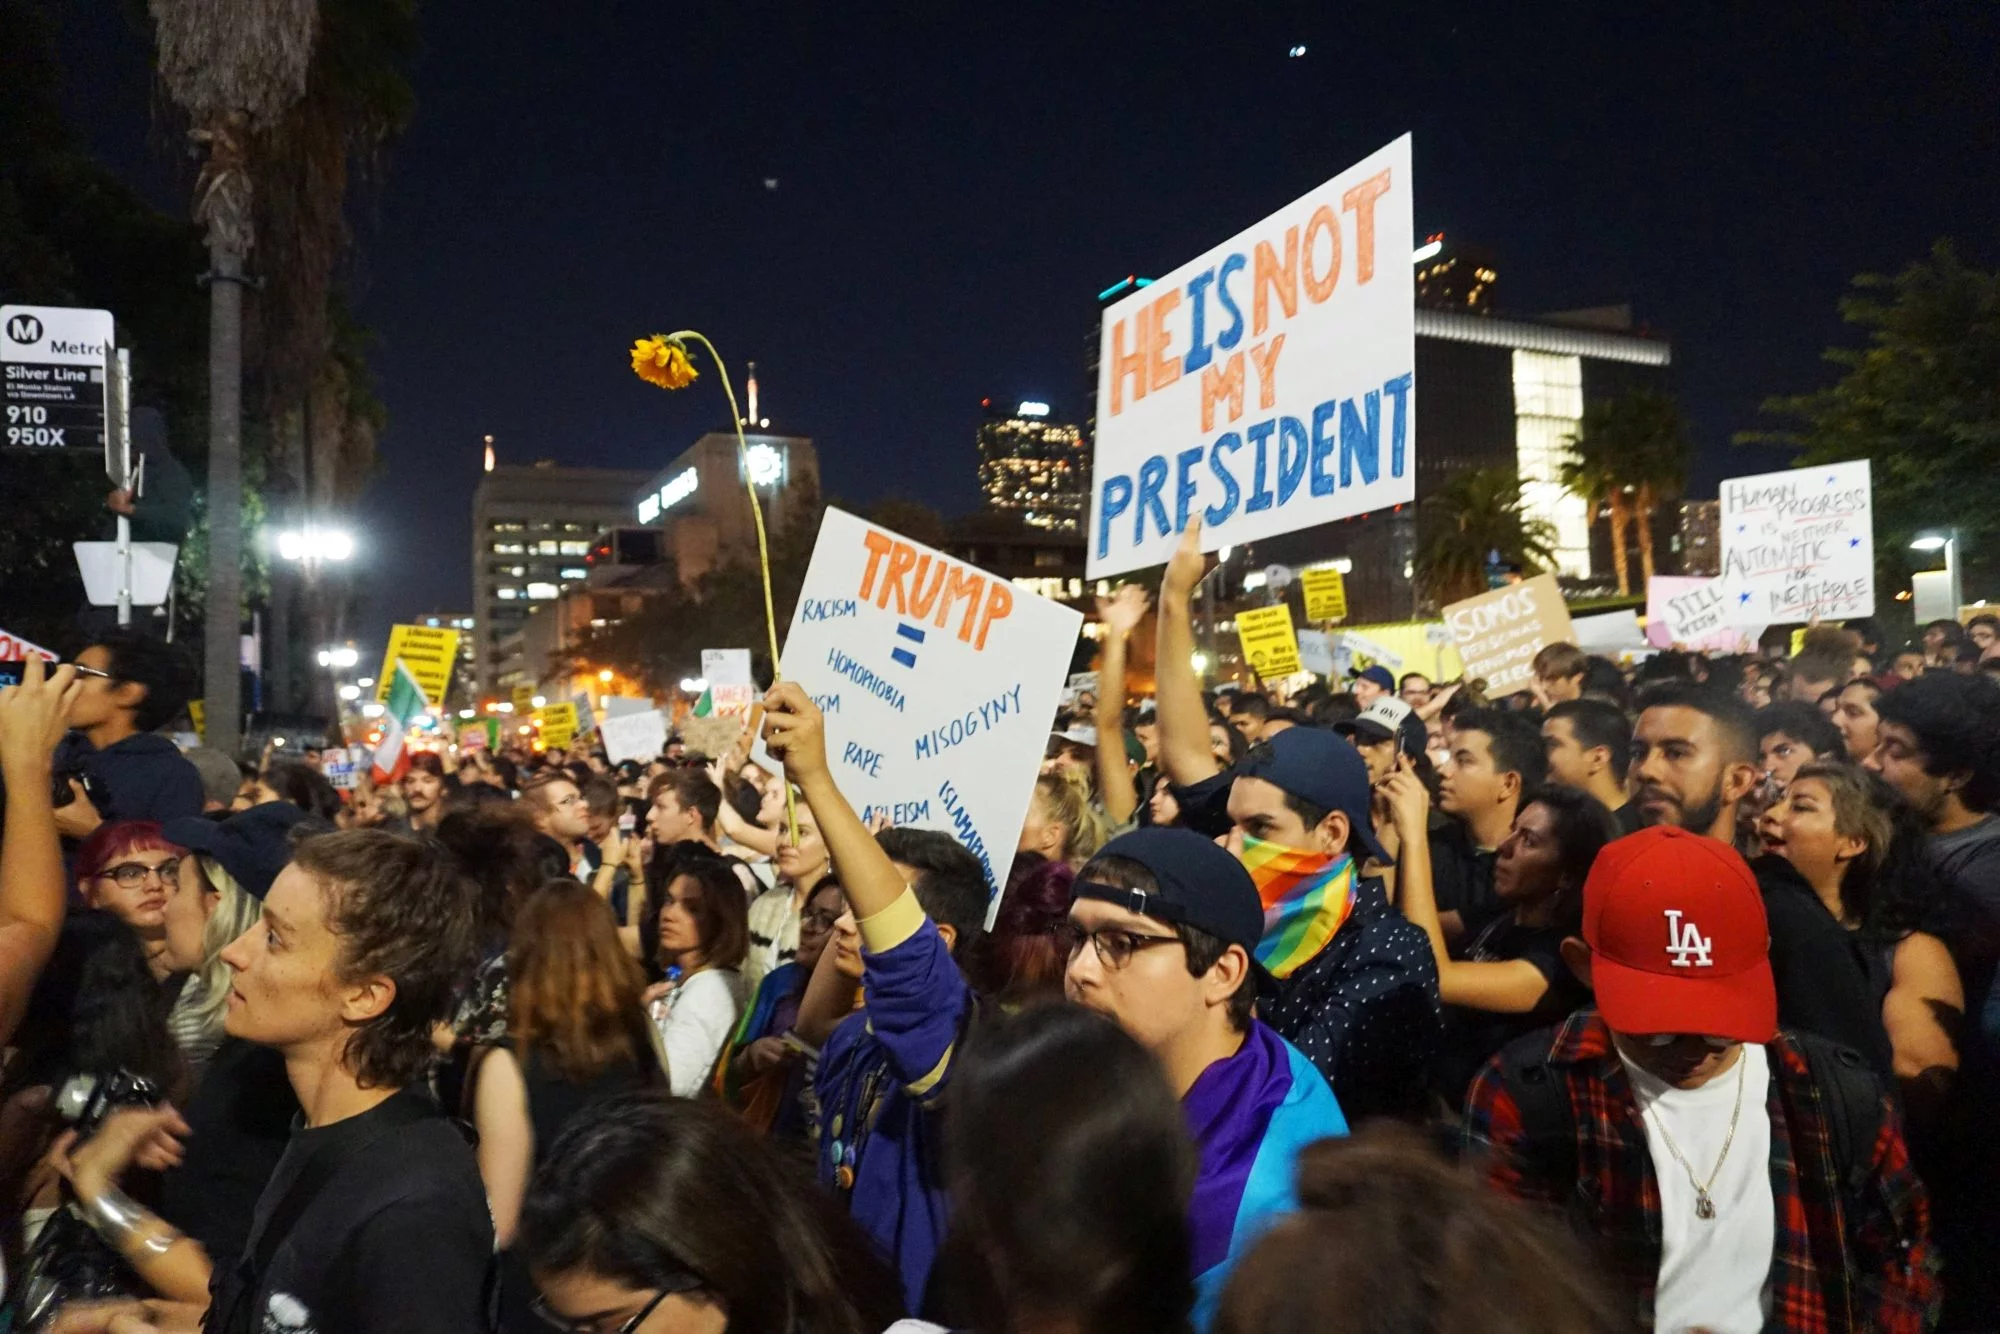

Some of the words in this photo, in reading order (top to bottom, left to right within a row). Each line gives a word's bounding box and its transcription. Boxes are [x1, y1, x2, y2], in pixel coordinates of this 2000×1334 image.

[1109, 288, 1181, 416] HE
[1184, 253, 1246, 375] IS
[1253, 168, 1391, 337] NOT
[6, 366, 49, 380] Silver
[54, 368, 87, 381] Line
[1201, 334, 1285, 432] MY
[7, 405, 46, 424] 910
[7, 427, 65, 446] 950X
[1097, 372, 1412, 559] PRESIDENT
[1777, 488, 1866, 520] PROGRESS
[1781, 519, 1849, 542] NEITHER
[1721, 540, 1831, 585] AUTOMATIC
[858, 529, 1013, 651] TRUMP
[1770, 577, 1868, 614] INEVITABLE
[801, 599, 857, 623] RACISM
[827, 648, 907, 712] HOMOPHOBIA
[914, 684, 1021, 760] MISOGYNY
[843, 741, 884, 778] RAPE
[1664, 910, 1713, 966] LA
